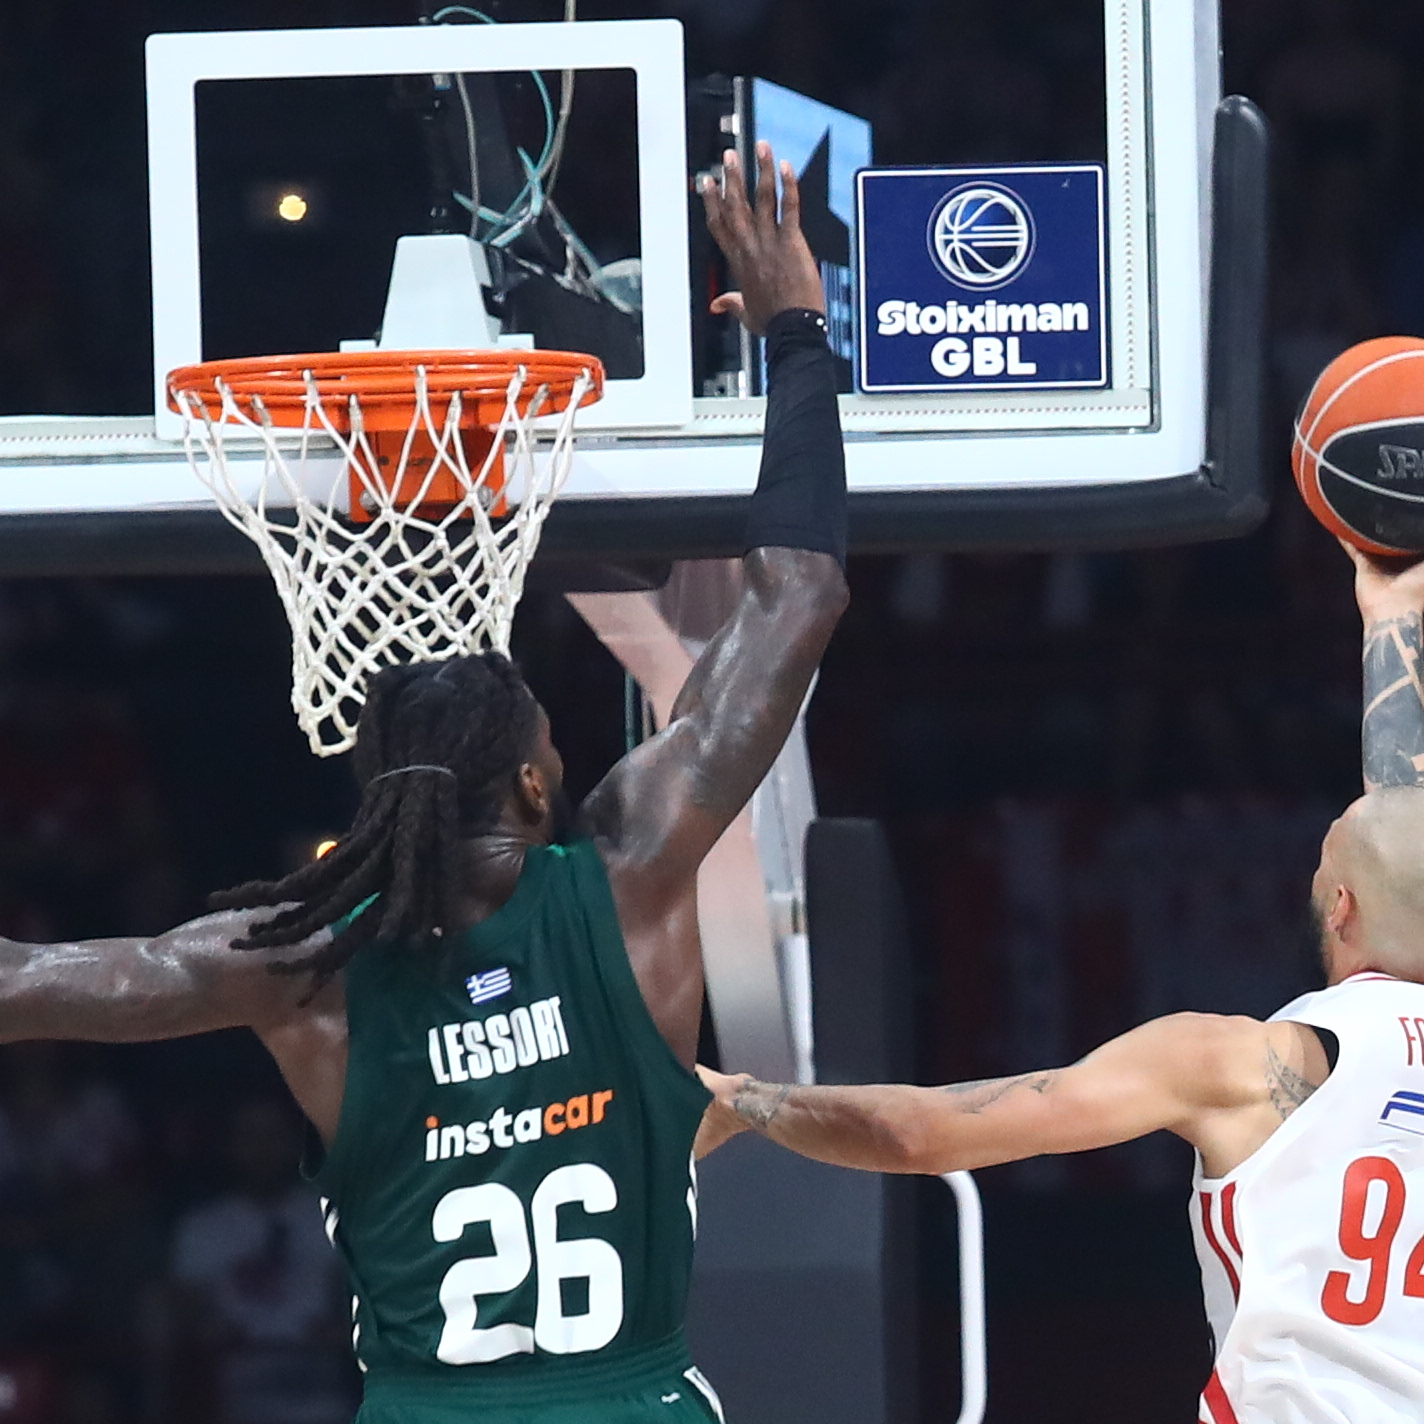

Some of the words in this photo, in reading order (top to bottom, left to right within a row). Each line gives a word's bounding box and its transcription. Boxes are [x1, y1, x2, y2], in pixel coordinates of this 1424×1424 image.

[877, 299, 1089, 335] Stoiximan
[930, 336, 1037, 377] GBL
[427, 995, 571, 1084] LESSORT
[424, 1088, 615, 1162] instacar
[431, 1162, 625, 1365] 26
